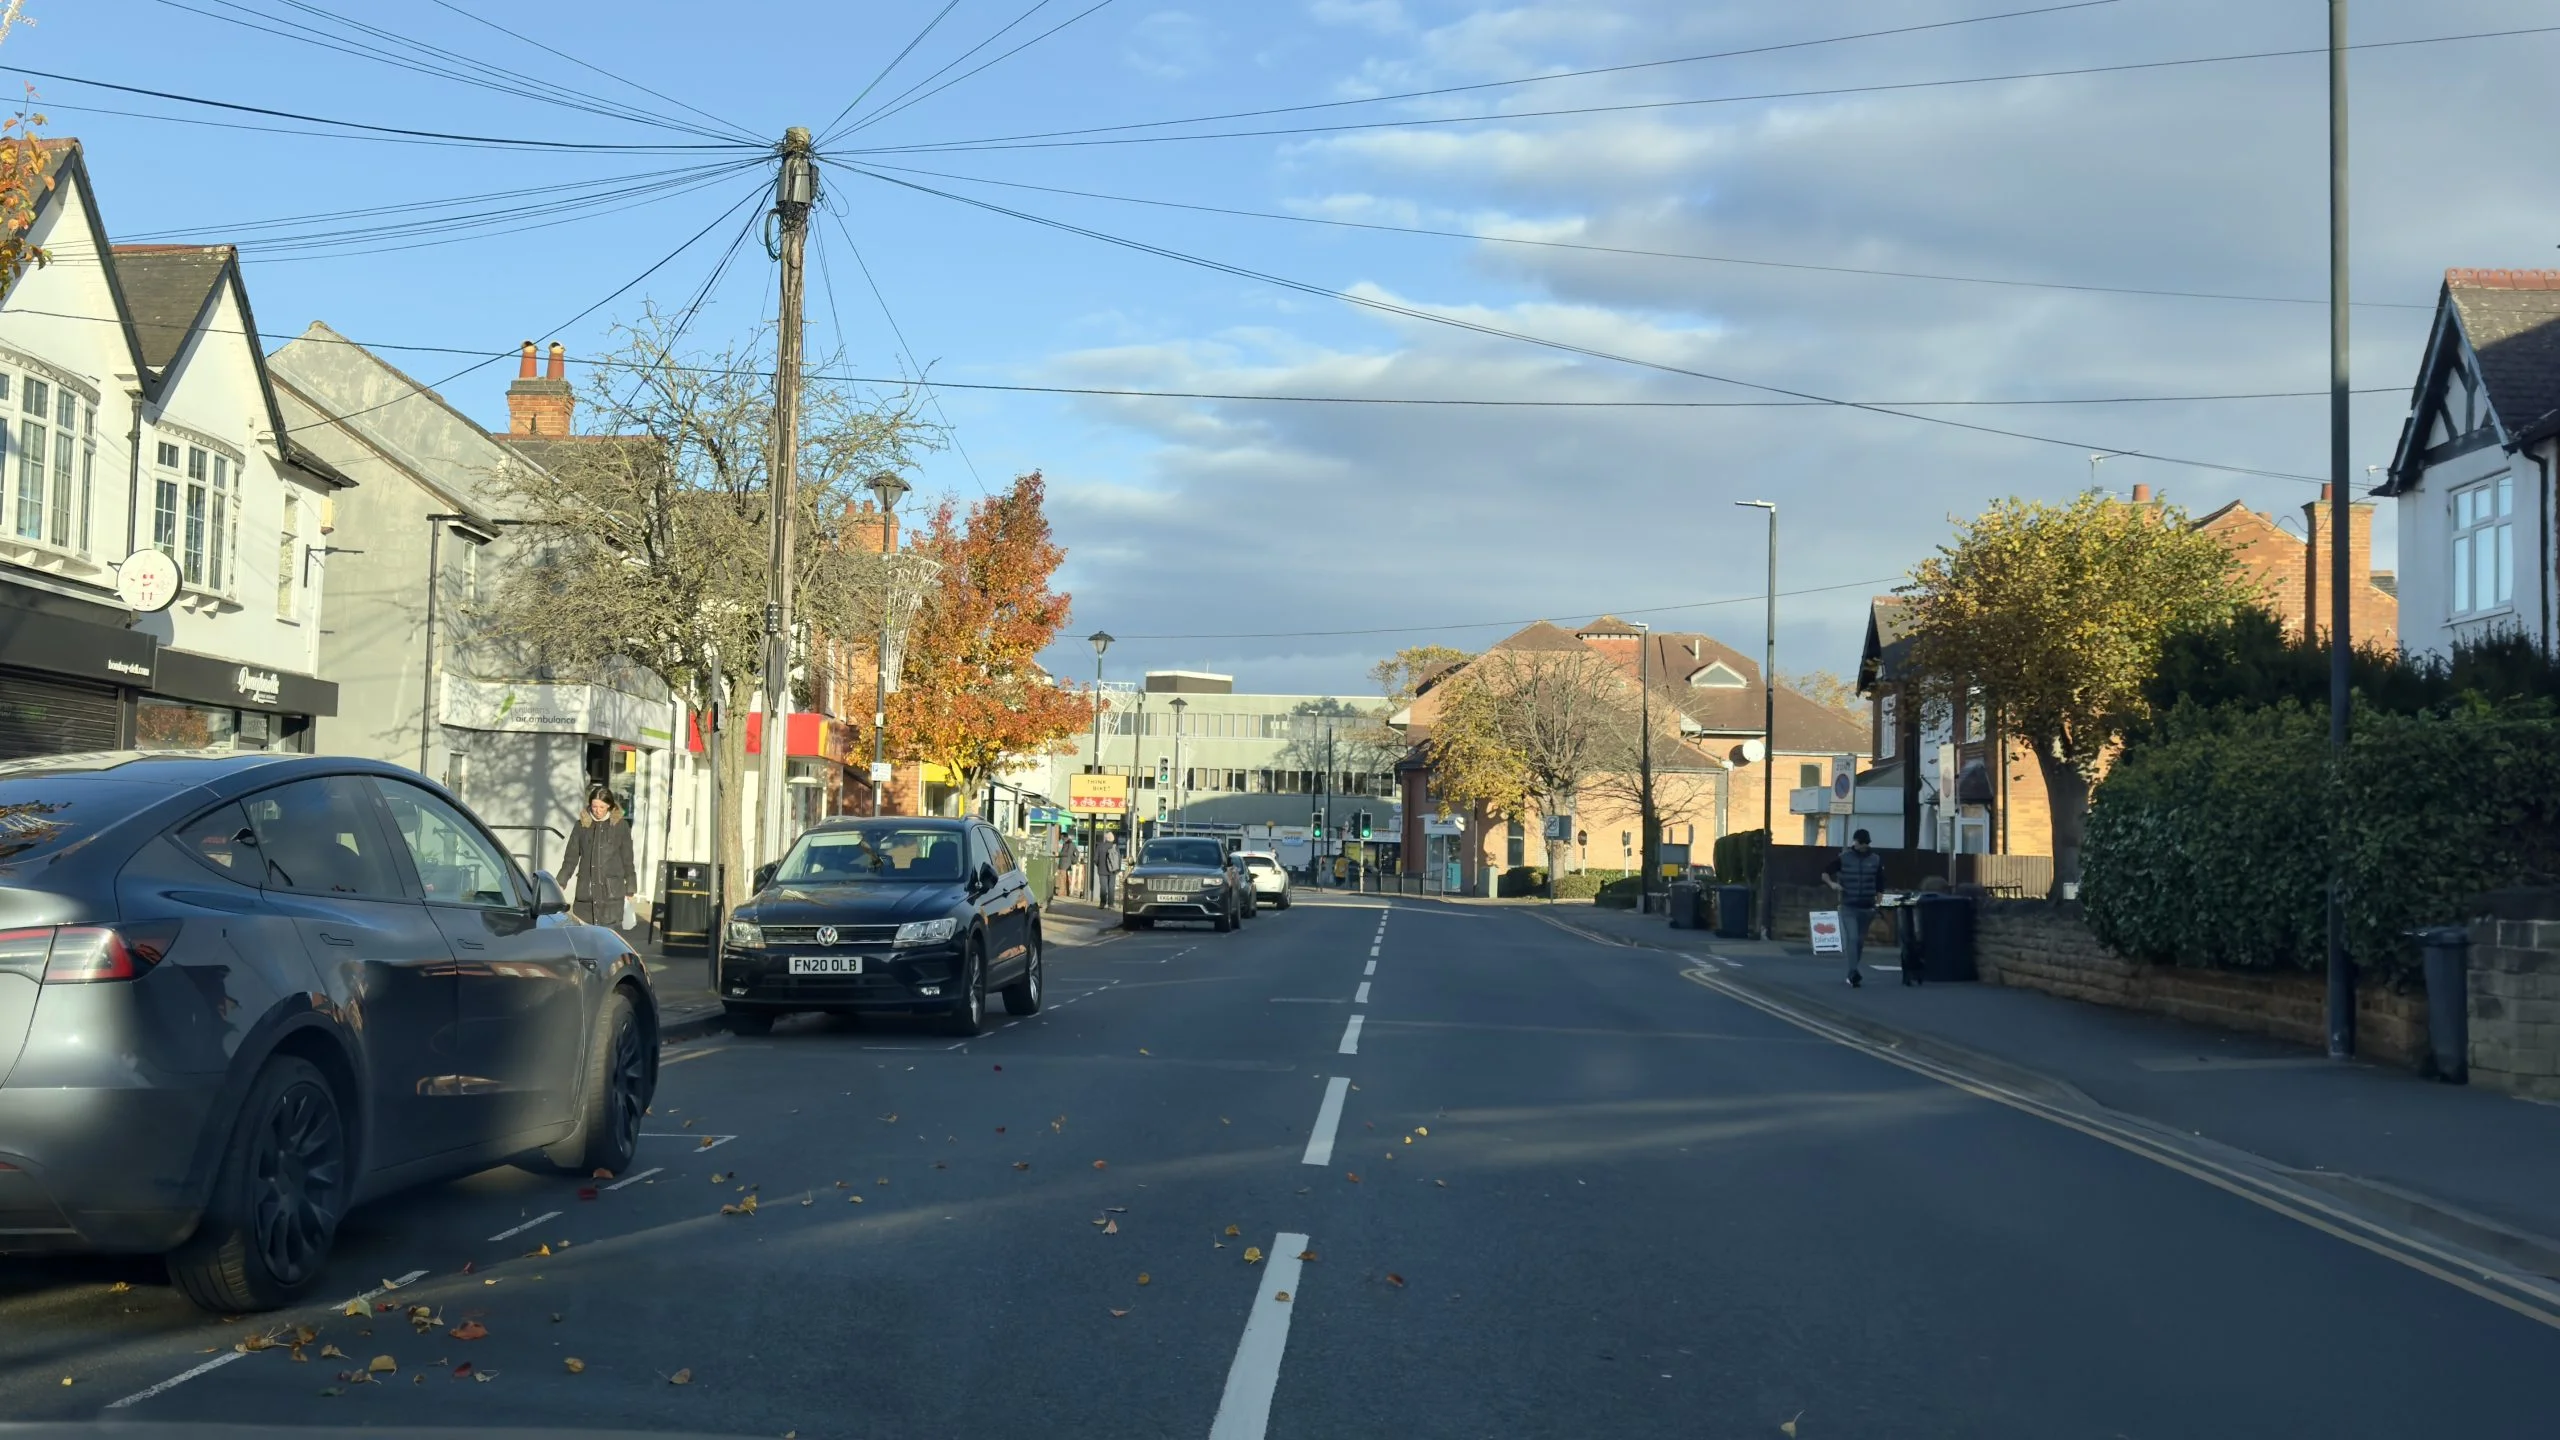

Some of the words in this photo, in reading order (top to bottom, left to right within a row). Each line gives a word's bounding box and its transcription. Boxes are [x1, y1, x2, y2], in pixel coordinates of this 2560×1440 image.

[515, 715, 526, 723] air
[528, 715, 576, 725] ambulance
[794, 959, 828, 972] FN20
[831, 959, 857, 972] OLB
